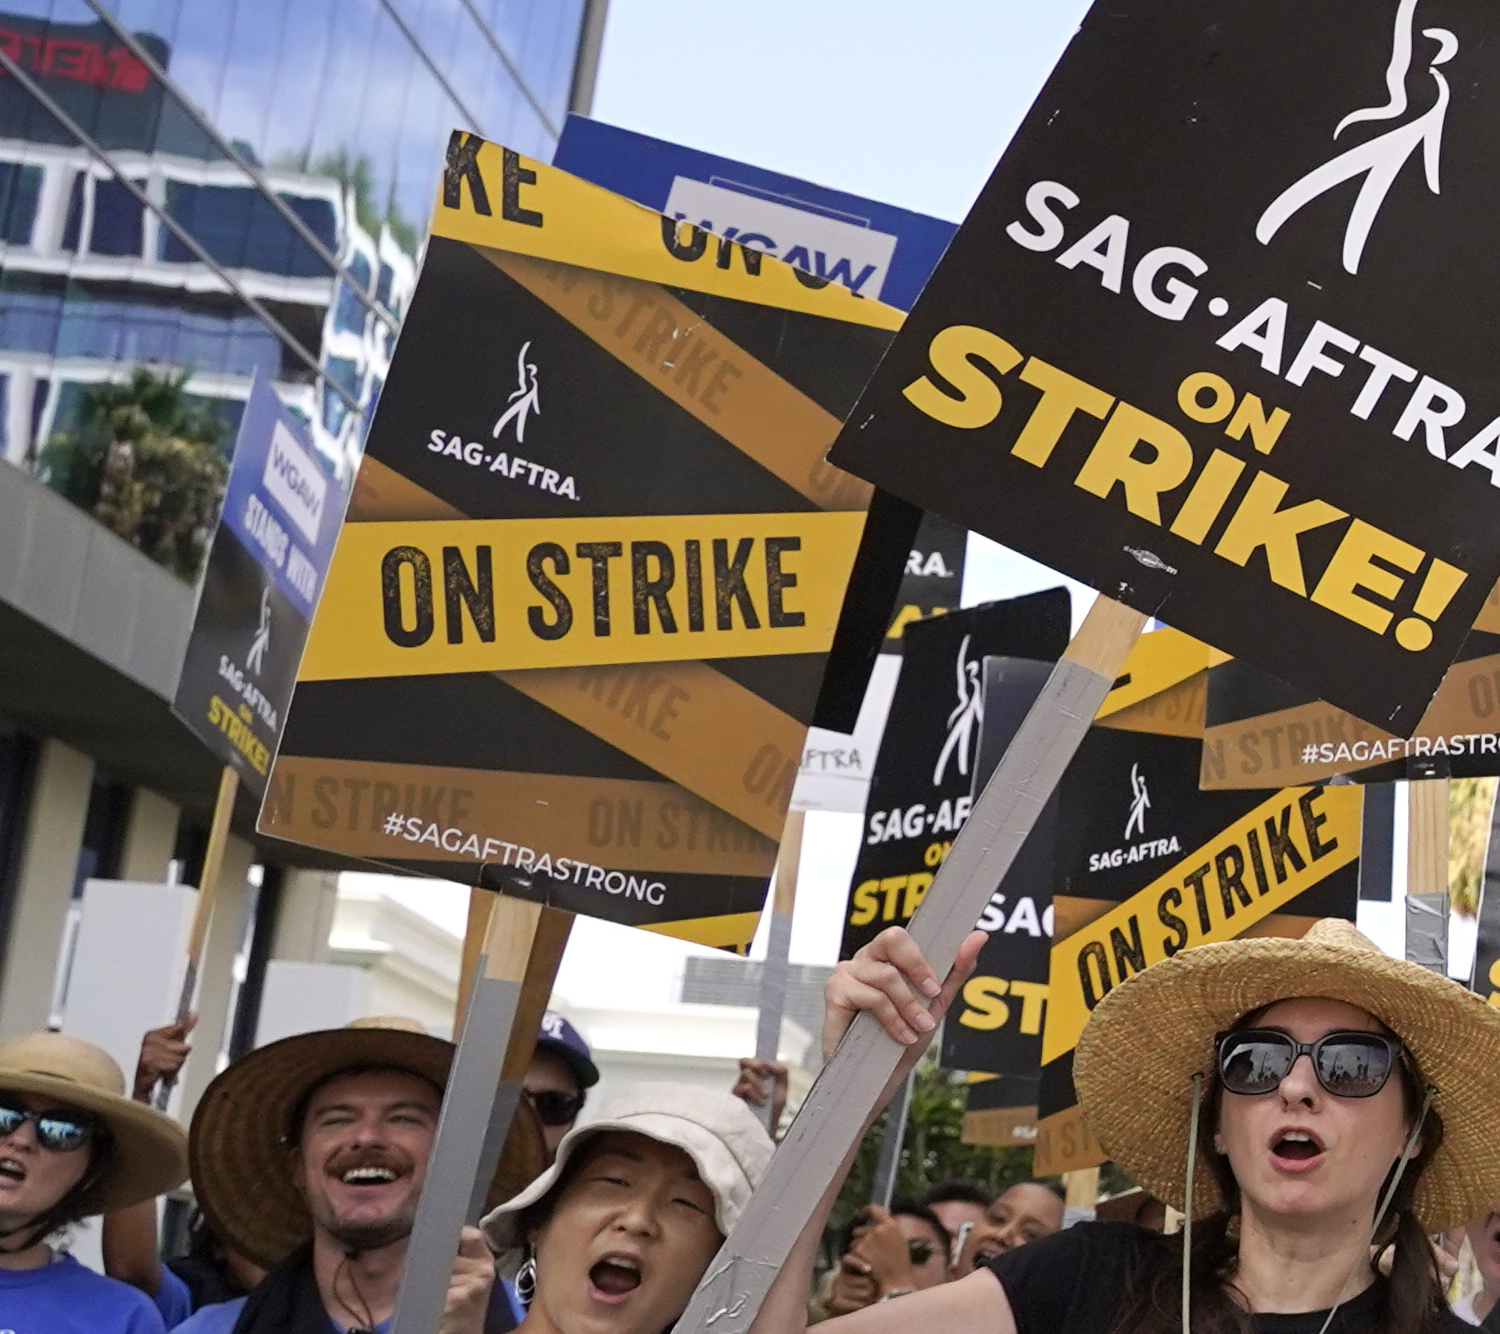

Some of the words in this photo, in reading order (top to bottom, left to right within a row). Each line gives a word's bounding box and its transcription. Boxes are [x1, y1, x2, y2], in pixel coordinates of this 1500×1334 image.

[1177, 371, 1291, 455] ON
[902, 324, 1469, 652] STRIKE!
[380, 544, 497, 649] ON
[526, 535, 806, 642] STRIKE
[383, 811, 667, 907] #SAGAFTRASTRONG
[867, 796, 973, 845] SAG·AF
[1076, 914, 1147, 1014] ON
[1157, 785, 1339, 963] STRIKE
